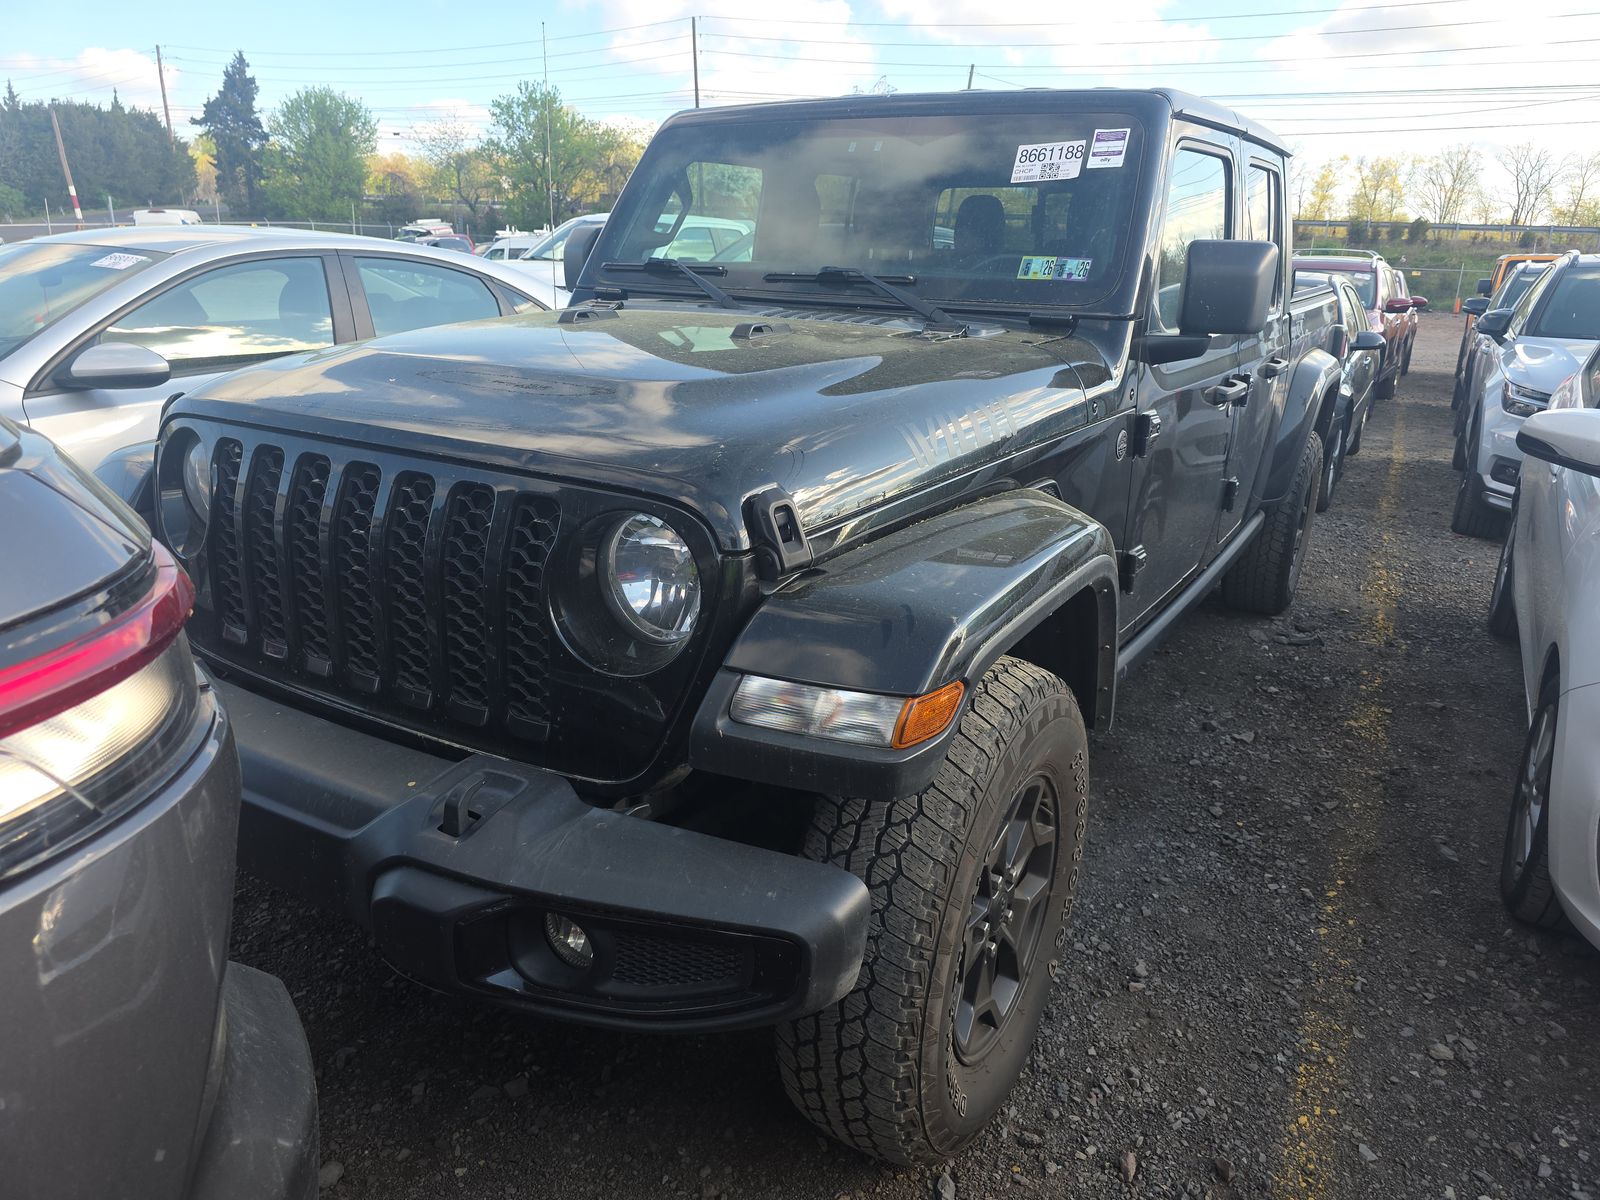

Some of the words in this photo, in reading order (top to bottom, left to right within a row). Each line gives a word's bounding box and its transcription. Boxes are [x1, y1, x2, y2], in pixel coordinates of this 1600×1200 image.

[1019, 144, 1085, 163] 8661188
[1042, 260, 1055, 276] 26
[1077, 261, 1090, 277] 26
